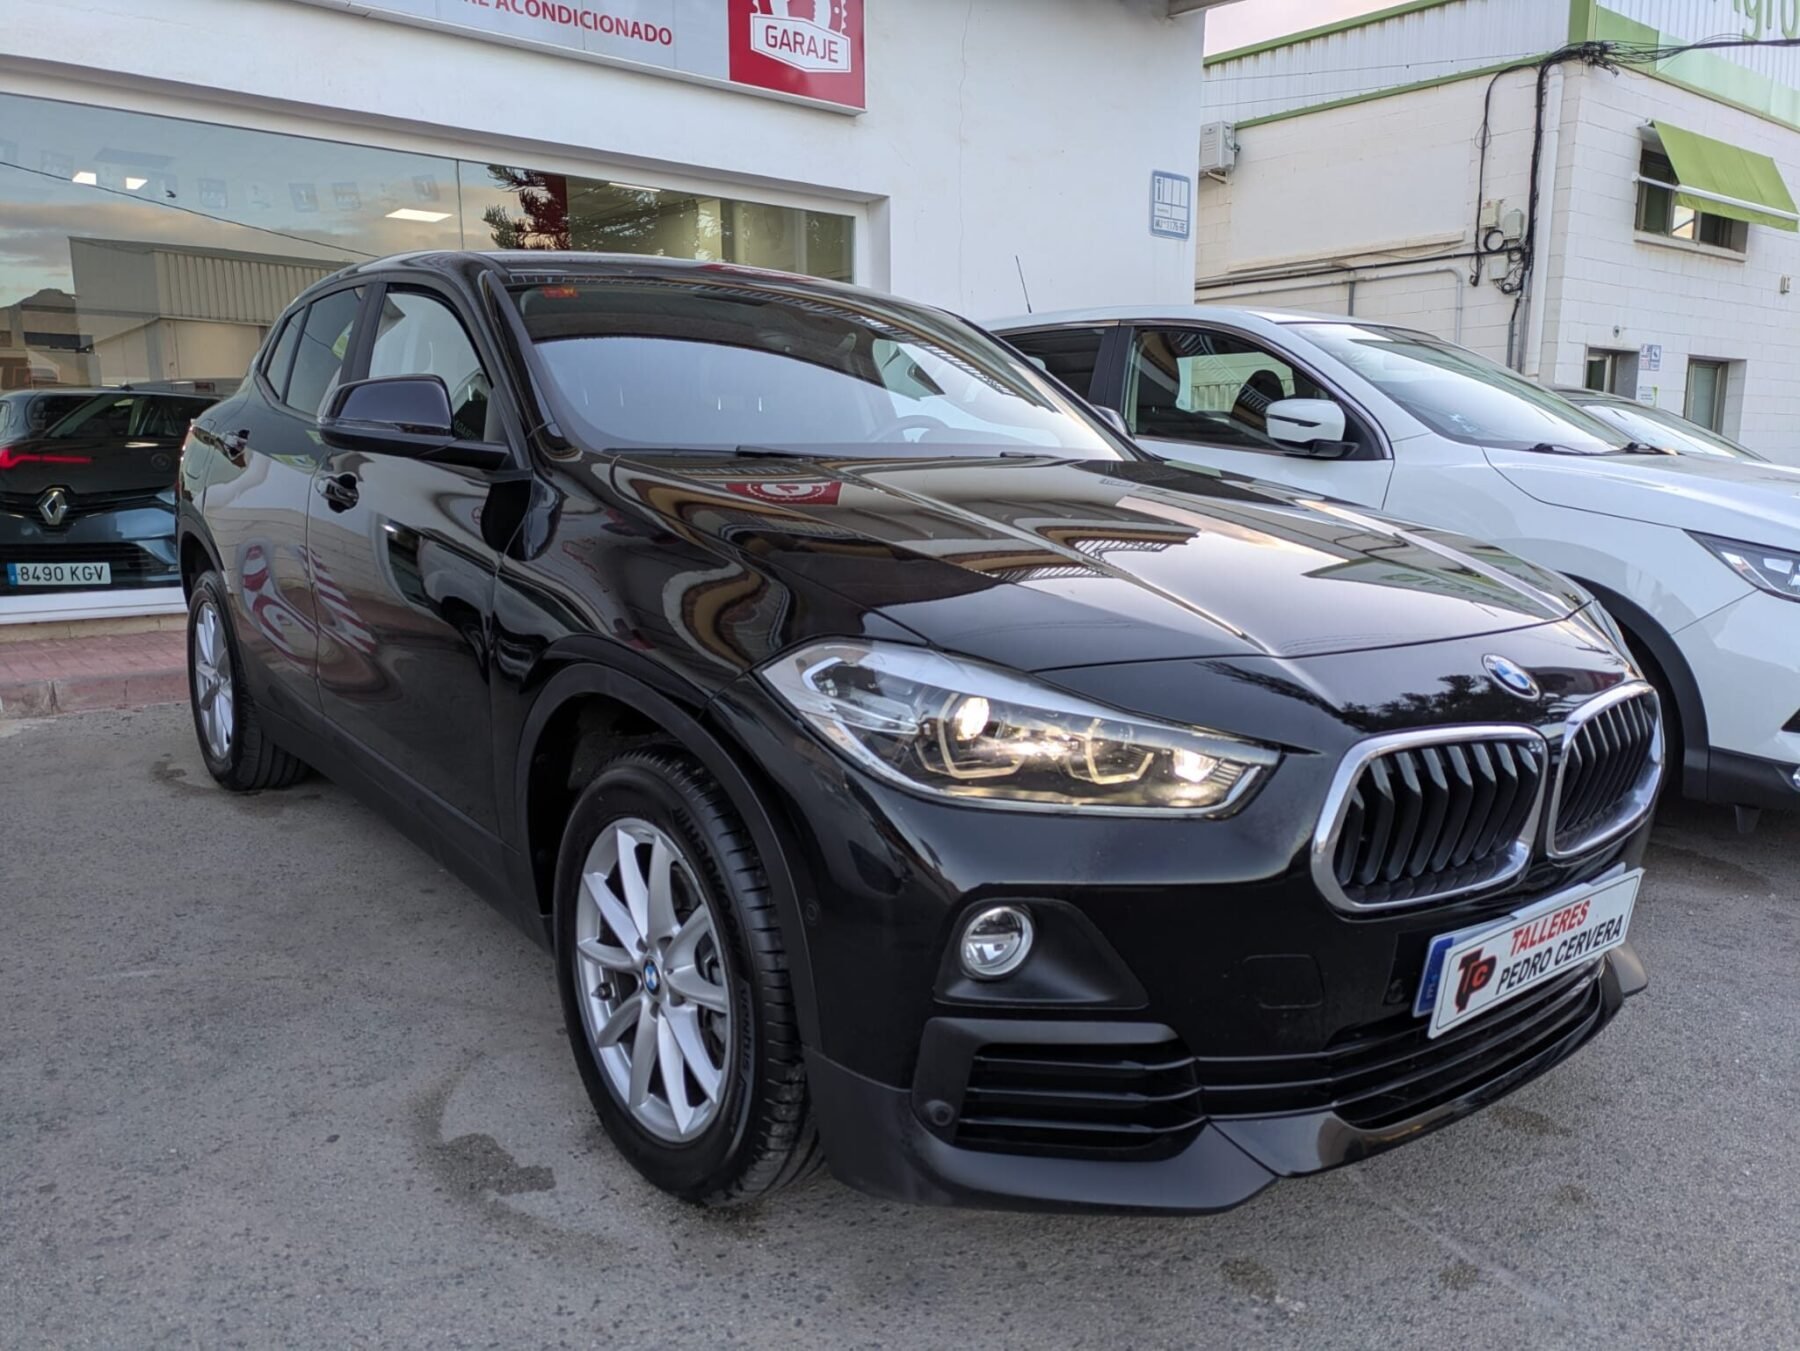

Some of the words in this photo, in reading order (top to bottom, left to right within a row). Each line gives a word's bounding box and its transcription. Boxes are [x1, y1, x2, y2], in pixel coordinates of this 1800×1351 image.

[765, 24, 839, 63] GARAJE
[20, 566, 64, 582] 8490
[70, 566, 104, 582] KGV
[1510, 899, 1591, 957] TALLERES
[1496, 947, 1553, 996] PEDRO
[1554, 914, 1624, 966] CERVERA
